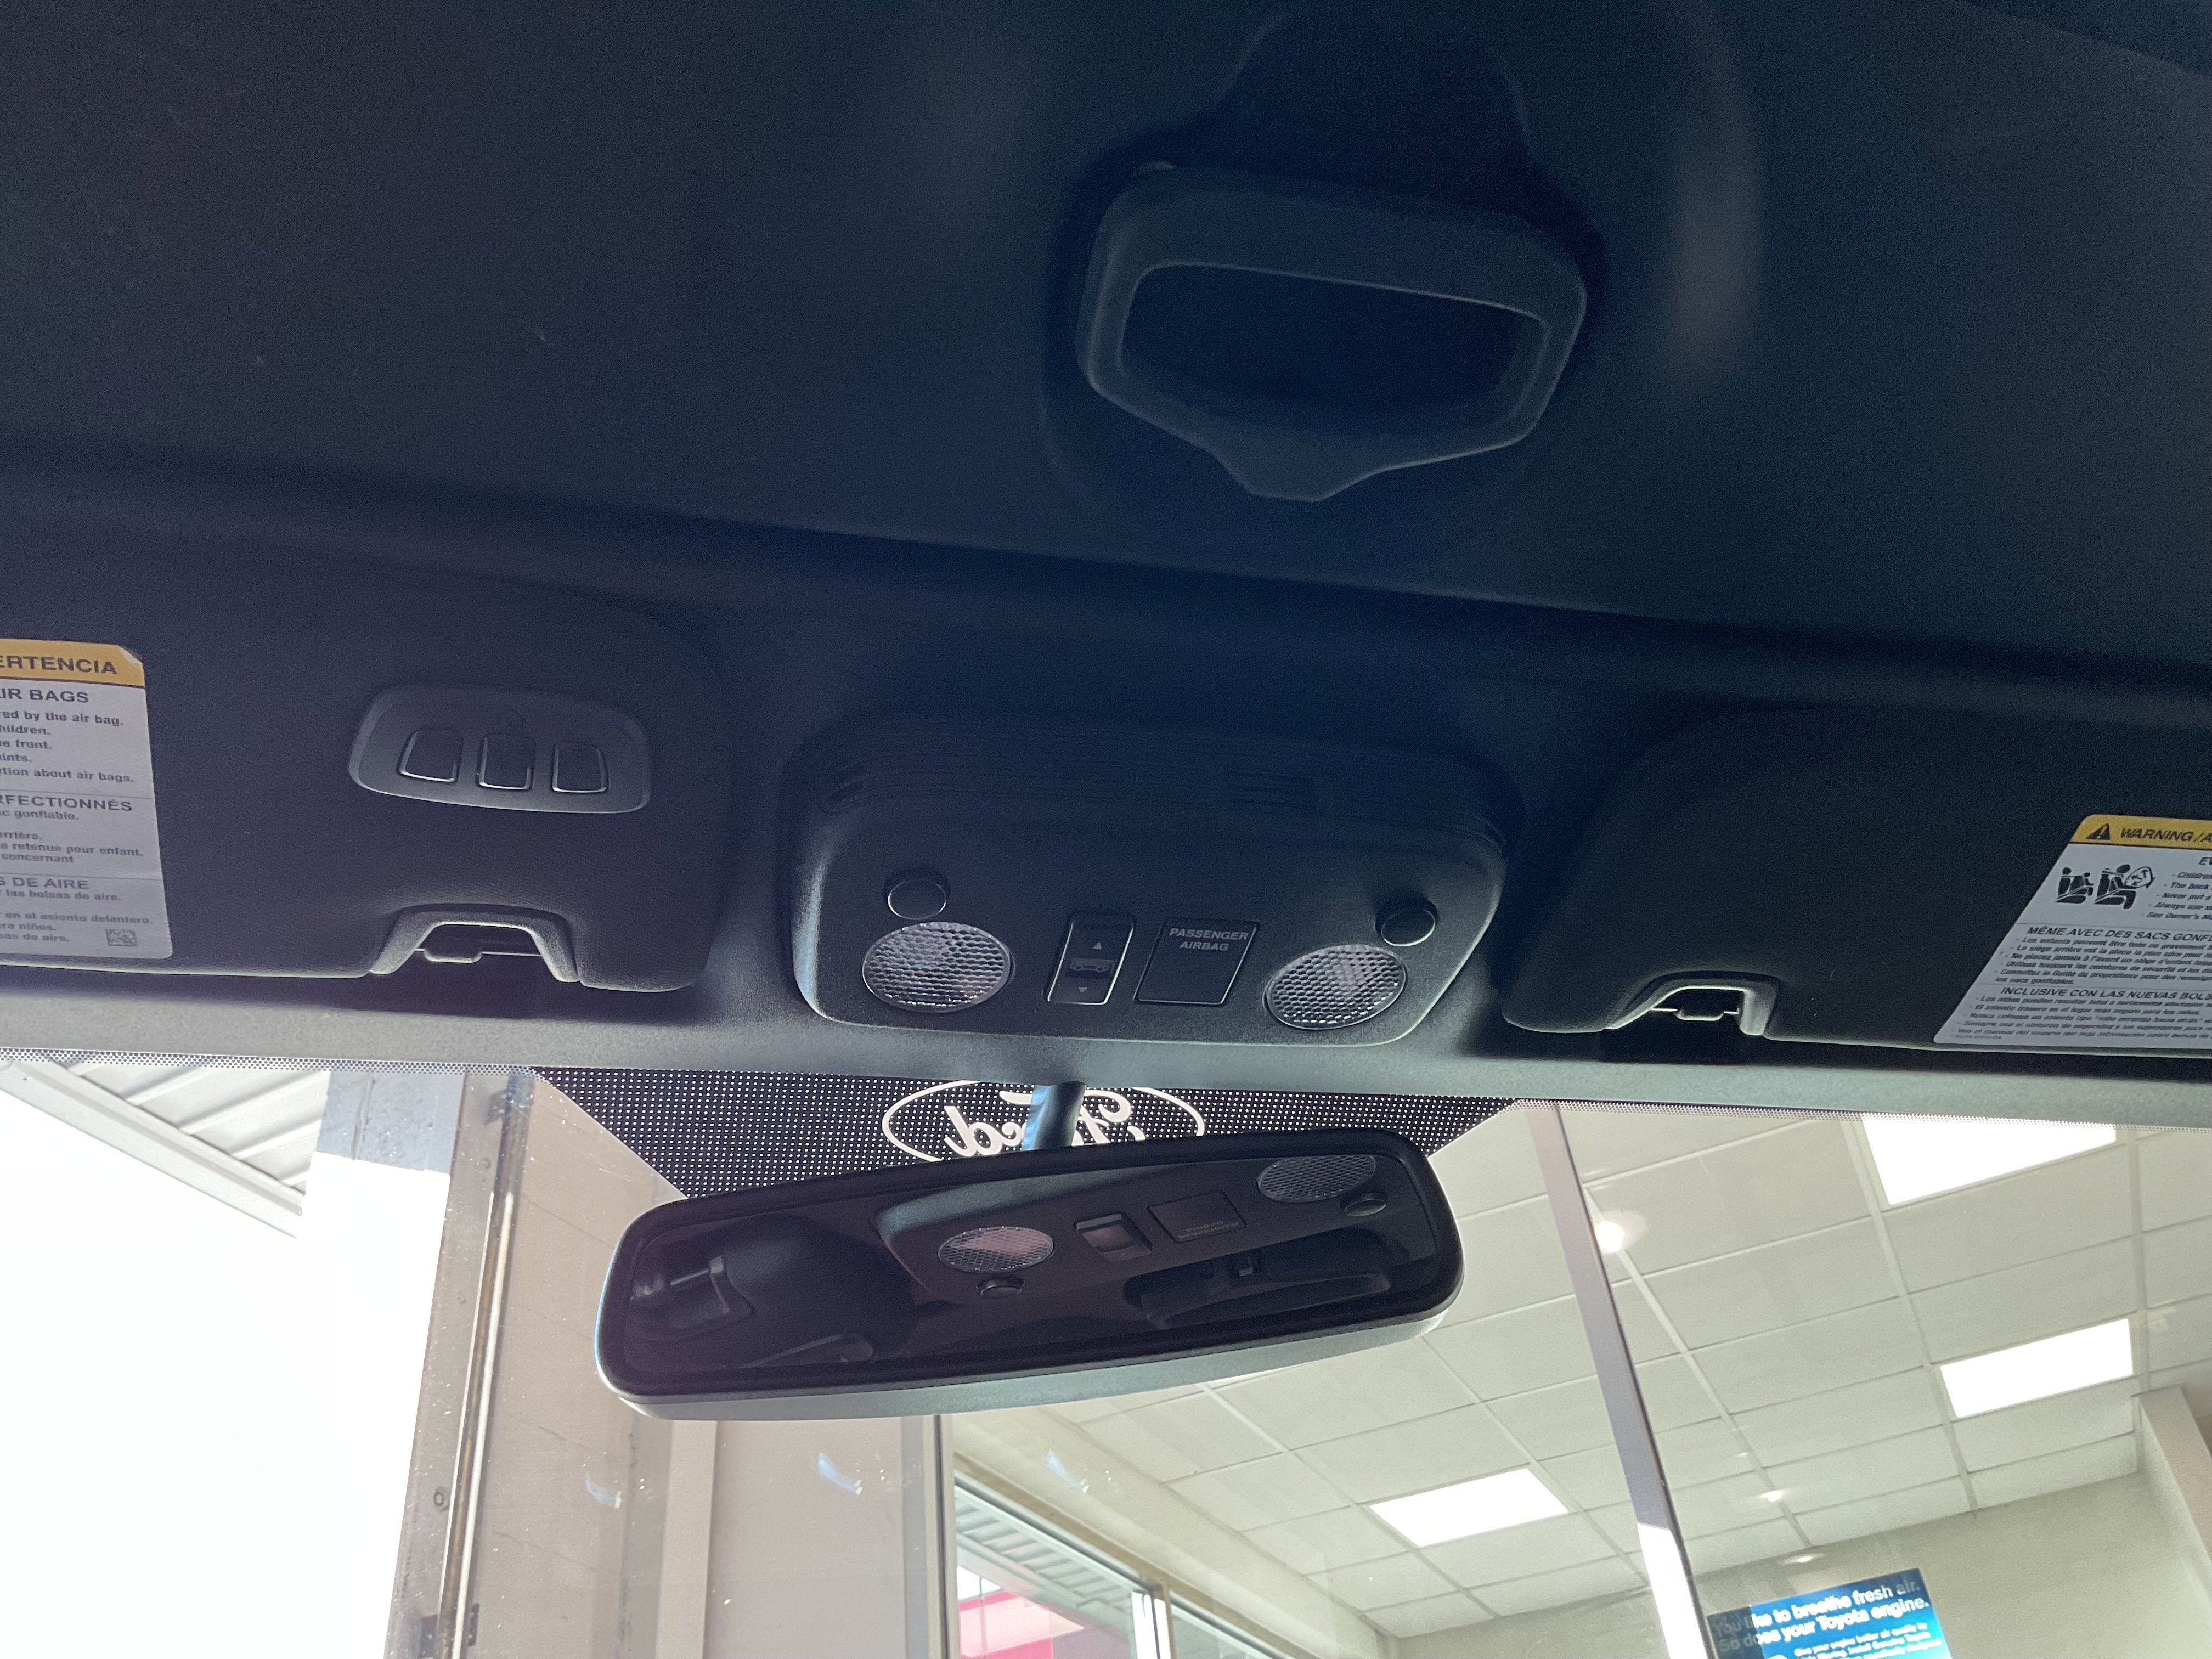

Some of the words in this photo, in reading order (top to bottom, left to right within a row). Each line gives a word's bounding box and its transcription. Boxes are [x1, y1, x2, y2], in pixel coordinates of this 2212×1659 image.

[0, 688, 22, 699] IR
[30, 690, 89, 703] BAGS
[0, 710, 19, 719] ed
[24, 710, 40, 721] by
[46, 712, 67, 721] the
[72, 714, 89, 723] air
[95, 715, 123, 726] bag.
[15, 739, 52, 749] front.
[0, 753, 32, 762] ints.
[33, 769, 72, 778] about
[77, 770, 94, 780] air
[99, 772, 134, 783] bags.
[14, 810, 79, 820] gonflable.
[2120, 828, 2194, 842] WARNING
[12, 843, 61, 851] retenue
[100, 847, 144, 856] enfant.
[1, 854, 74, 863] concernant
[12, 877, 38, 887] DE
[44, 878, 89, 889] AIRE
[6, 889, 25, 897] las
[29, 890, 70, 899] bolsas
[40, 913, 87, 922] asiento
[91, 915, 153, 924] delantero.
[1169, 928, 1249, 940] PASSENGER
[2027, 926, 2067, 935] MÊME
[2105, 930, 2132, 938] DES
[2134, 932, 2171, 940] SACS
[1179, 941, 1229, 951] AIRBAG
[2000, 987, 2068, 996] INCLUSIVE
[1773, 1609, 1792, 1623] to
[1791, 1595, 1852, 1619] breathe
[1852, 1585, 1894, 1605] fresh
[1896, 1579, 1920, 1595] air.
[1781, 1621, 1815, 1642] your
[1815, 1609, 1870, 1630] Toyota
[1870, 1598, 1930, 1619] engine.
